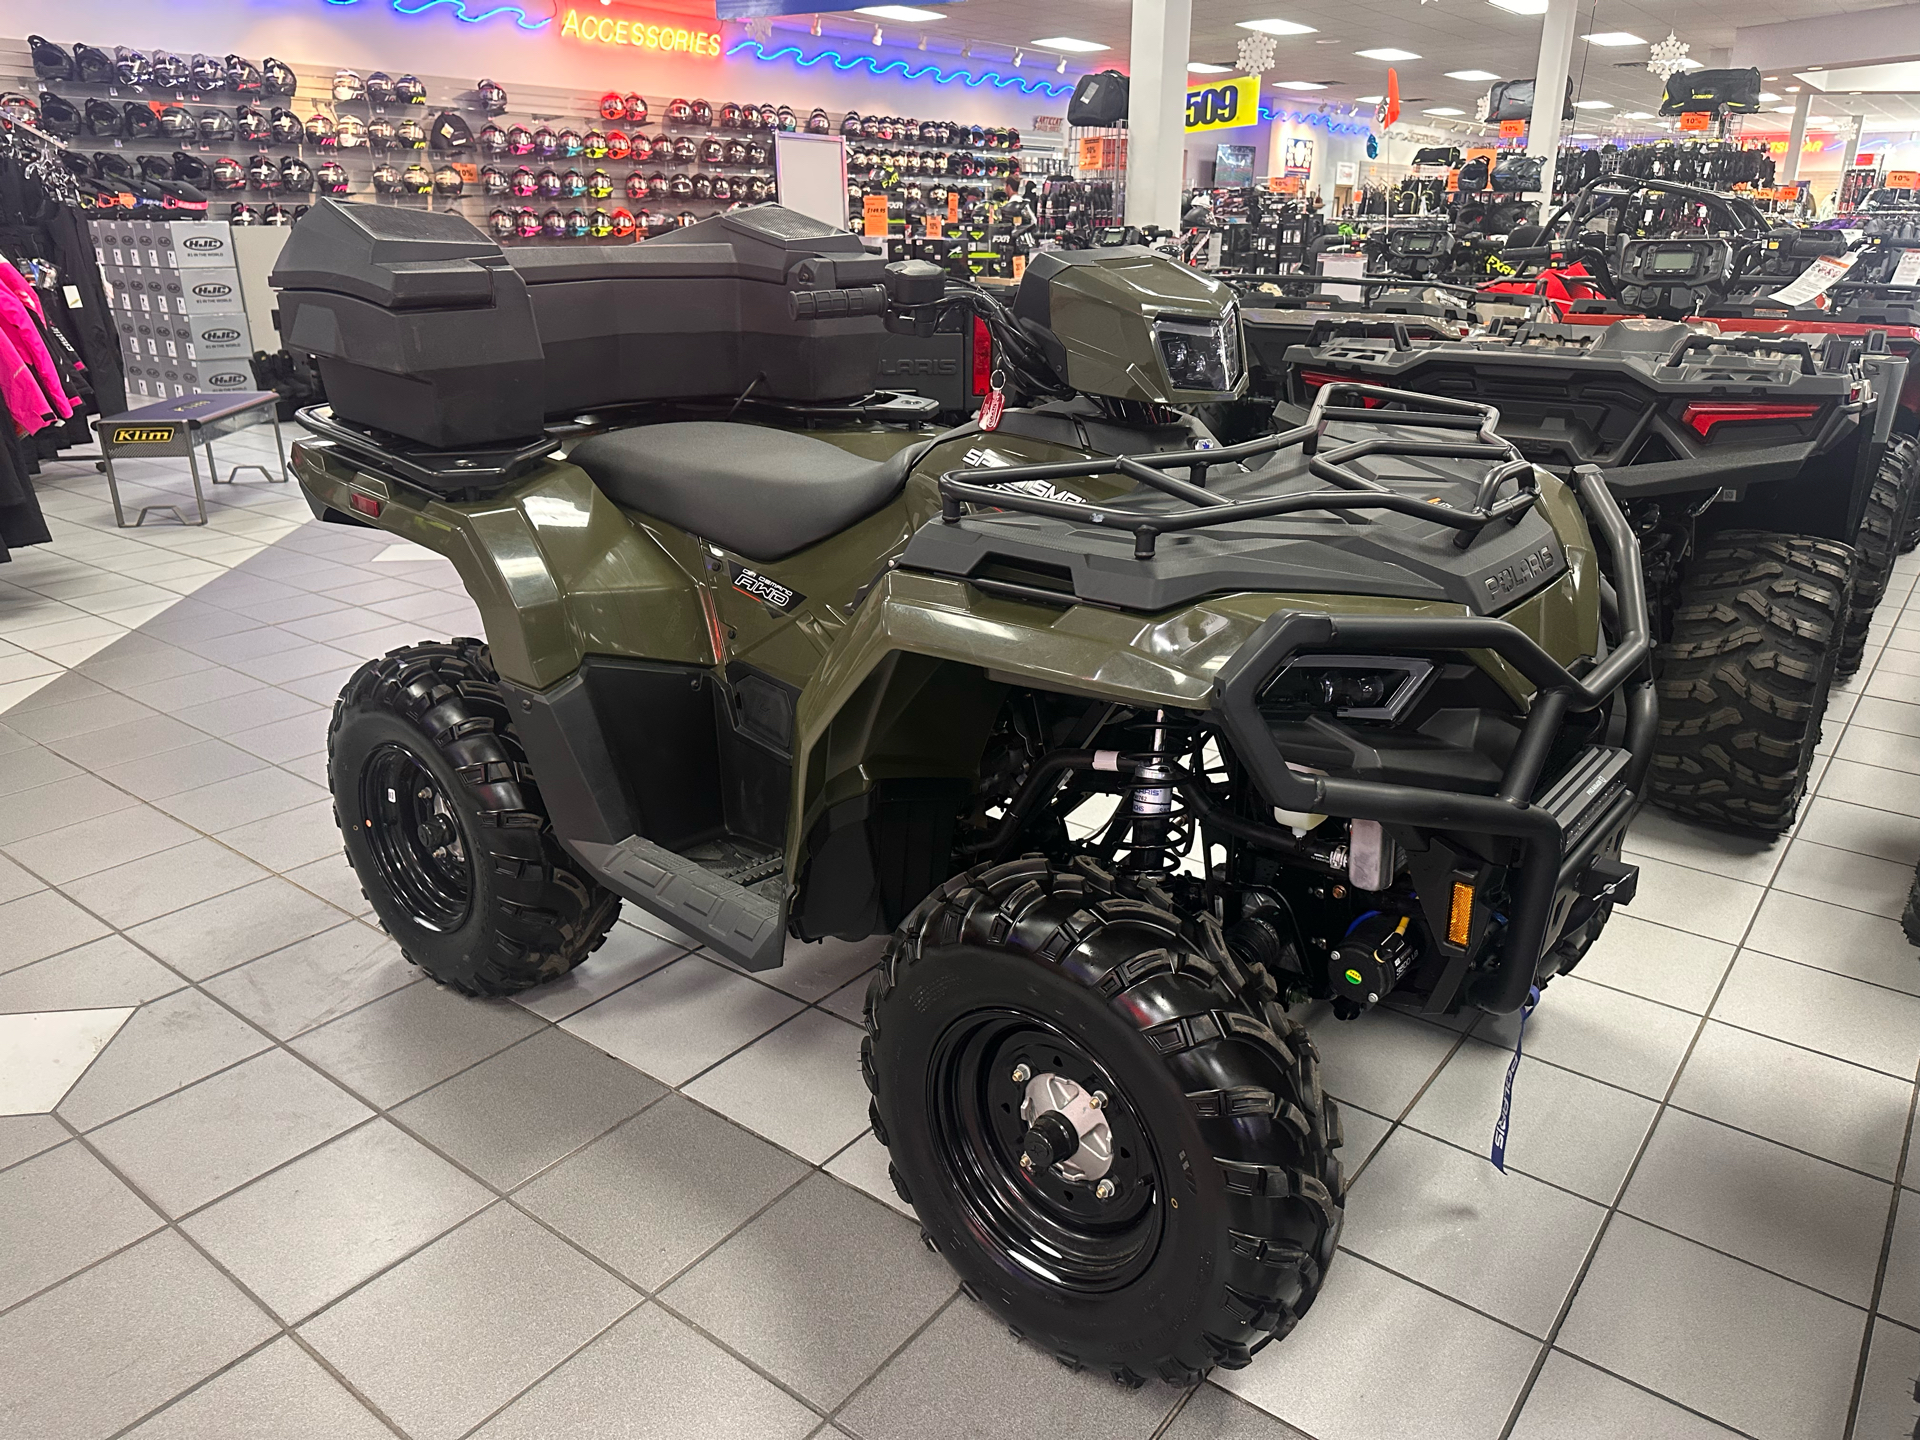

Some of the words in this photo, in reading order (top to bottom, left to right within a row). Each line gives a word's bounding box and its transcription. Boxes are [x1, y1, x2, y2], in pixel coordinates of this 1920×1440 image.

[561, 9, 721, 57] ACCESSORIES
[1185, 85, 1239, 127] 509
[992, 234, 1011, 243] FXR
[1487, 255, 1512, 275] FXR
[878, 358, 958, 377] LARIS
[734, 573, 790, 607] AWD
[1484, 545, 1555, 602] POLARIS
[1494, 1053, 1519, 1150] POLARIS
